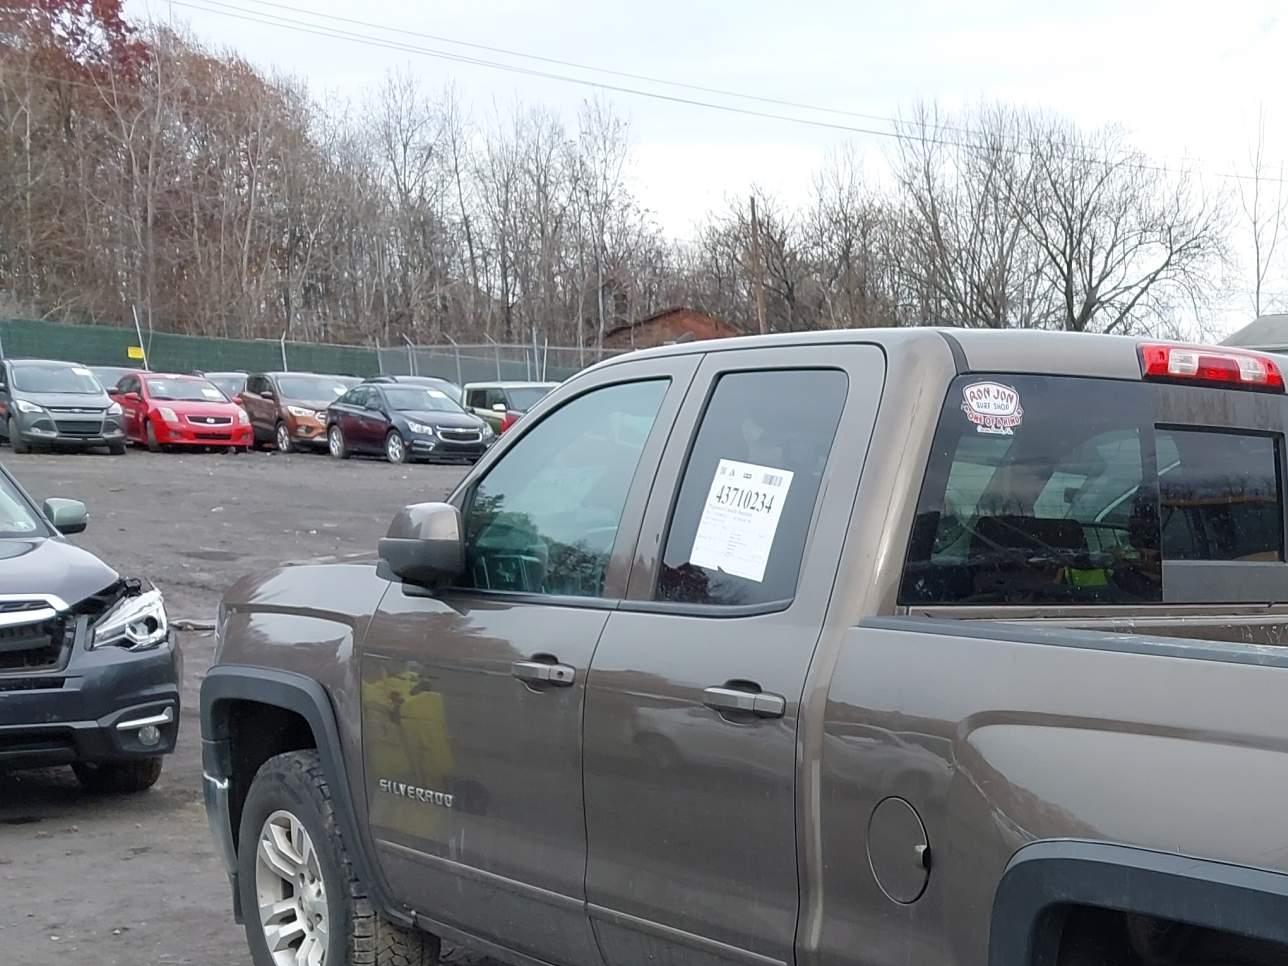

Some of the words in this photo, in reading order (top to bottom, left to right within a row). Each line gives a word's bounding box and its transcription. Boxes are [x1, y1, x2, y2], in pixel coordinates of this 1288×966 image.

[969, 387, 990, 402] RON
[993, 389, 1014, 404] JON
[993, 402, 1009, 411] SHOP
[715, 485, 775, 514] 43710234
[379, 778, 453, 808] SILVERADO
